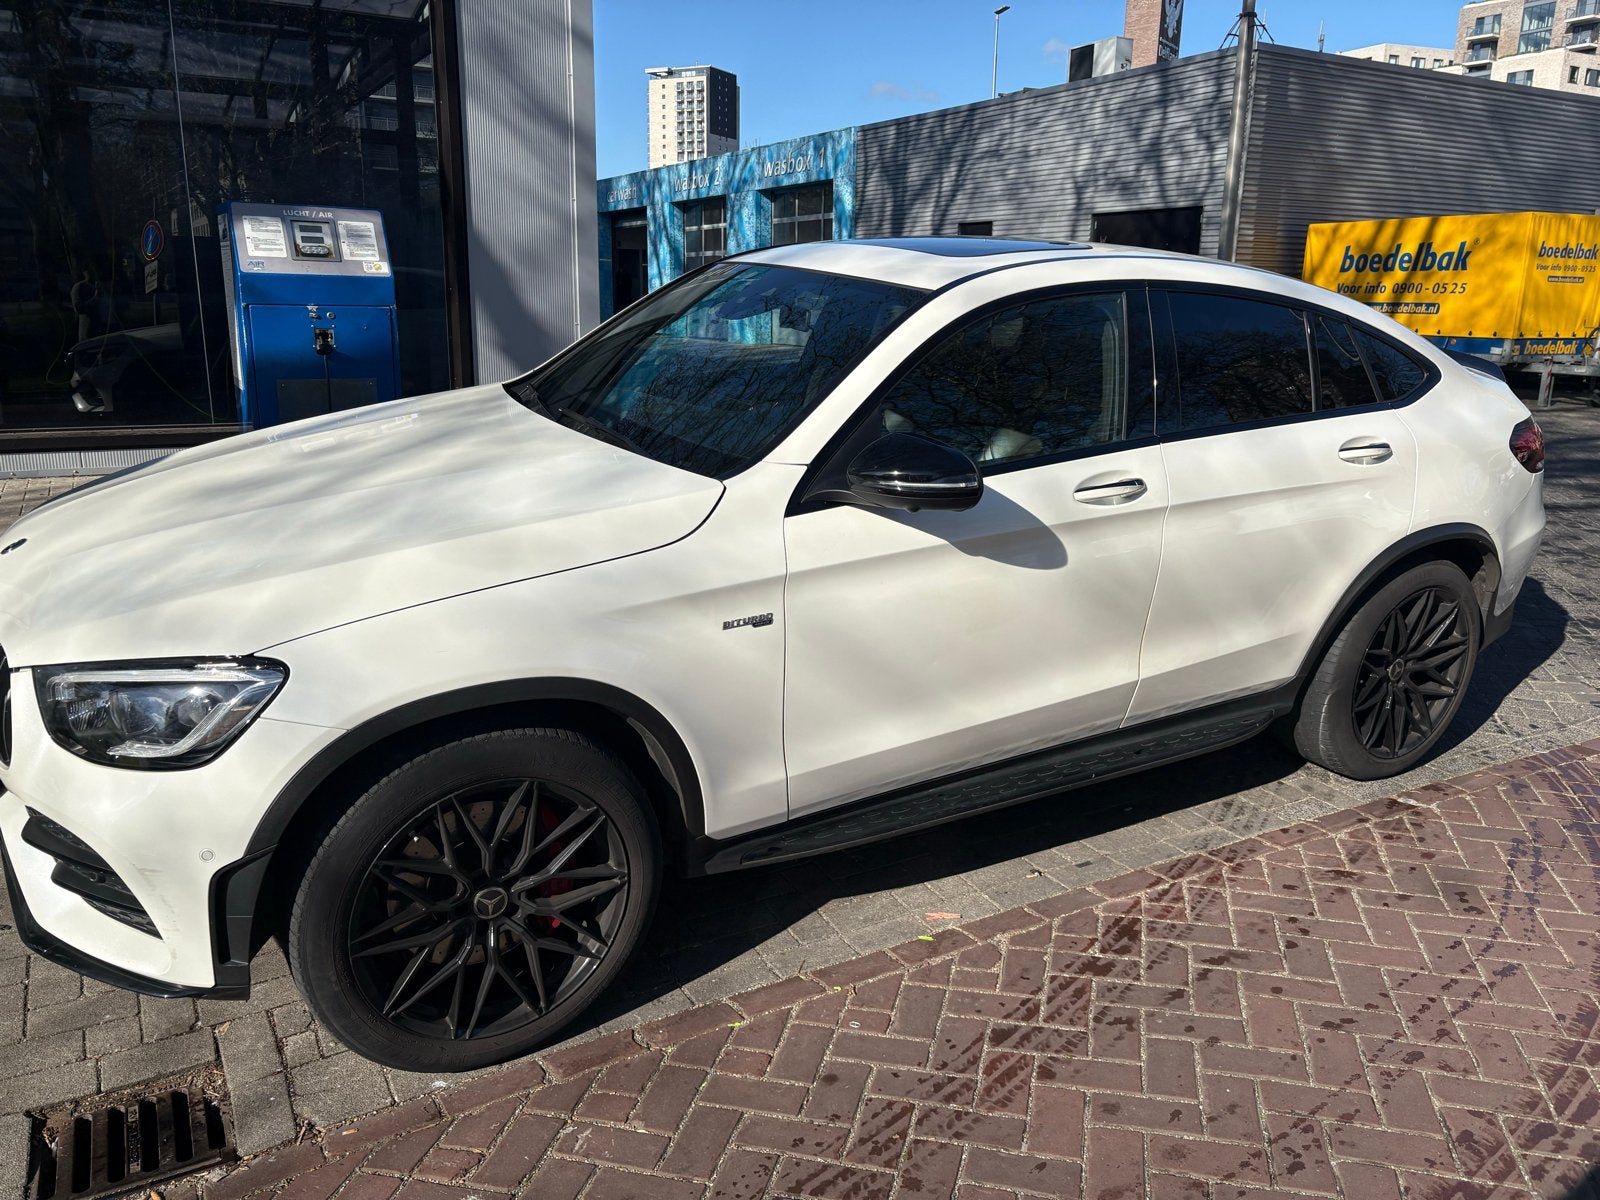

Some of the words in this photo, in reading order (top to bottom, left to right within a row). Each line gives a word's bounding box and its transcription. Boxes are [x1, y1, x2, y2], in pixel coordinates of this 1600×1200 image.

[763, 150, 811, 178] wasbox
[819, 146, 825, 169] 1
[713, 166, 720, 186] 2
[283, 209, 310, 217] LUCHT
[318, 211, 334, 219] AIR
[1339, 241, 1472, 273] boedelbak
[1538, 241, 1599, 259] boedelbak
[1535, 263, 1550, 271] Voor
[1337, 282, 1362, 294] Voor
[1364, 281, 1387, 294] info
[1370, 303, 1438, 314] w.boedelbak.nl
[1524, 340, 1578, 355] boedelbak
